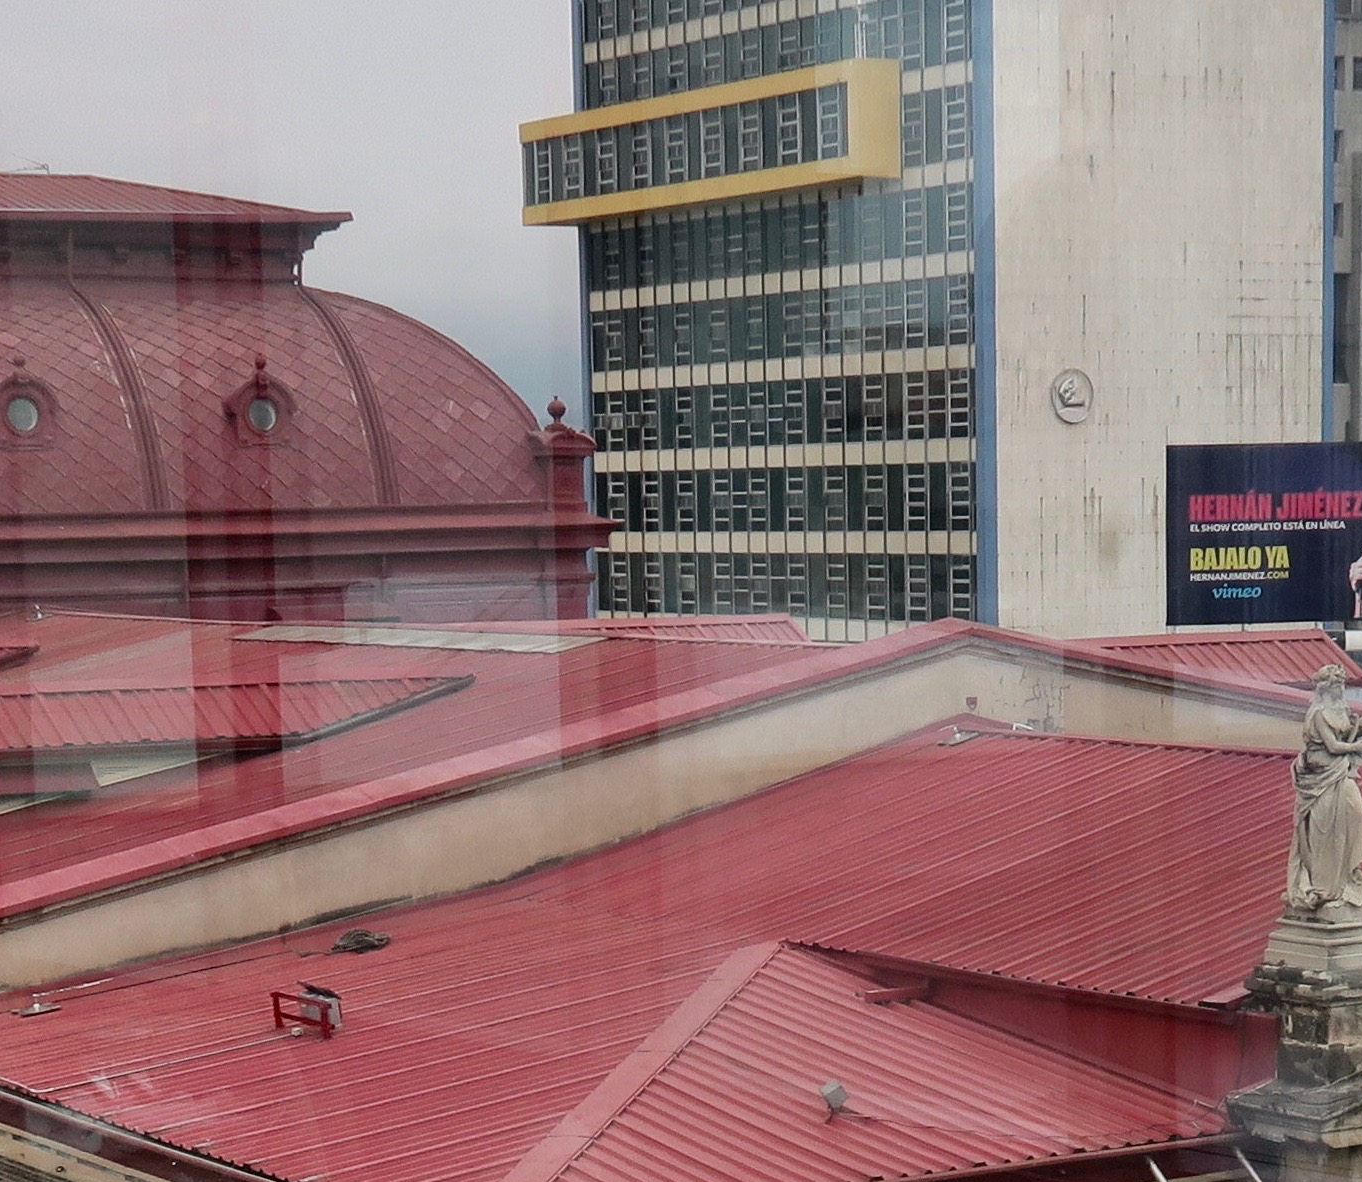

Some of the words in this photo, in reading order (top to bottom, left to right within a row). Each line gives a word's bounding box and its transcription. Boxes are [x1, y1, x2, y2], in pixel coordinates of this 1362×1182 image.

[1189, 489, 1272, 522] HERNÁN
[1190, 524, 1200, 533] EL
[1201, 523, 1230, 533] SHOW
[1231, 521, 1281, 532] COMPLETO
[1283, 519, 1304, 531] ESTÁ
[1305, 522, 1318, 531] EN
[1319, 519, 1346, 530] LÍNEA
[1190, 546, 1261, 572] BAJALO
[1265, 545, 1290, 570] YA
[1190, 571, 1289, 582] HERNANJIMENEZ.COM
[1212, 583, 1262, 599] vimeo
